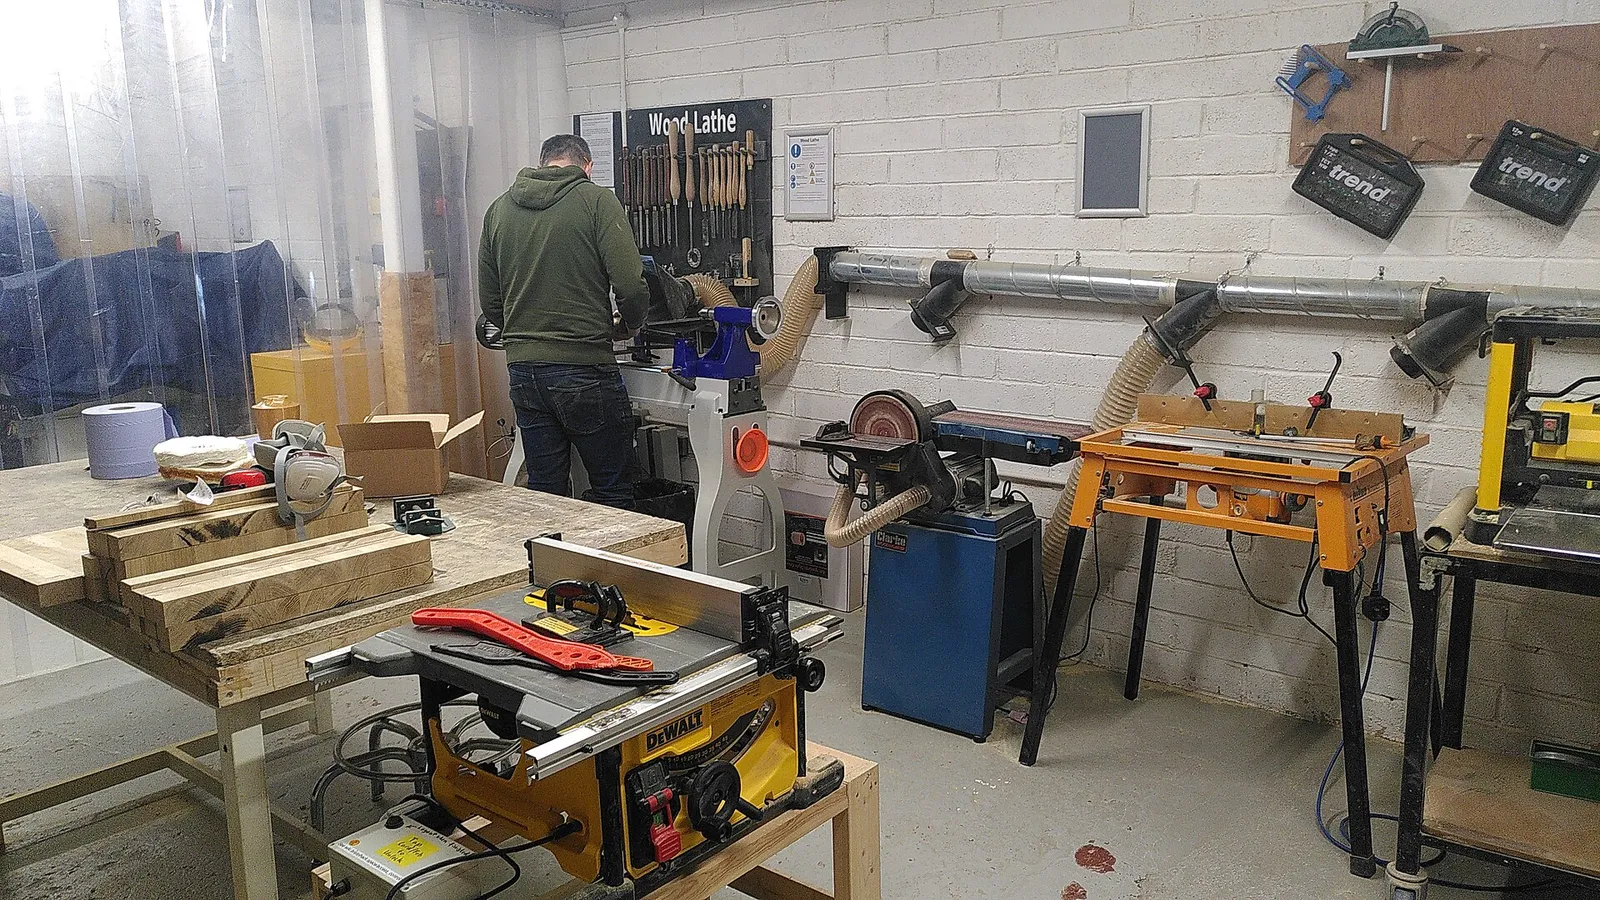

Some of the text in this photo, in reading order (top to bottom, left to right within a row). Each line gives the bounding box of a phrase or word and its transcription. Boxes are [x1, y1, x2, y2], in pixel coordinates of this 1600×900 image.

[693, 108, 736, 134] Lathe
[1328, 164, 1391, 202] trend
[1498, 156, 1567, 192] trend
[877, 531, 906, 546] Clarke
